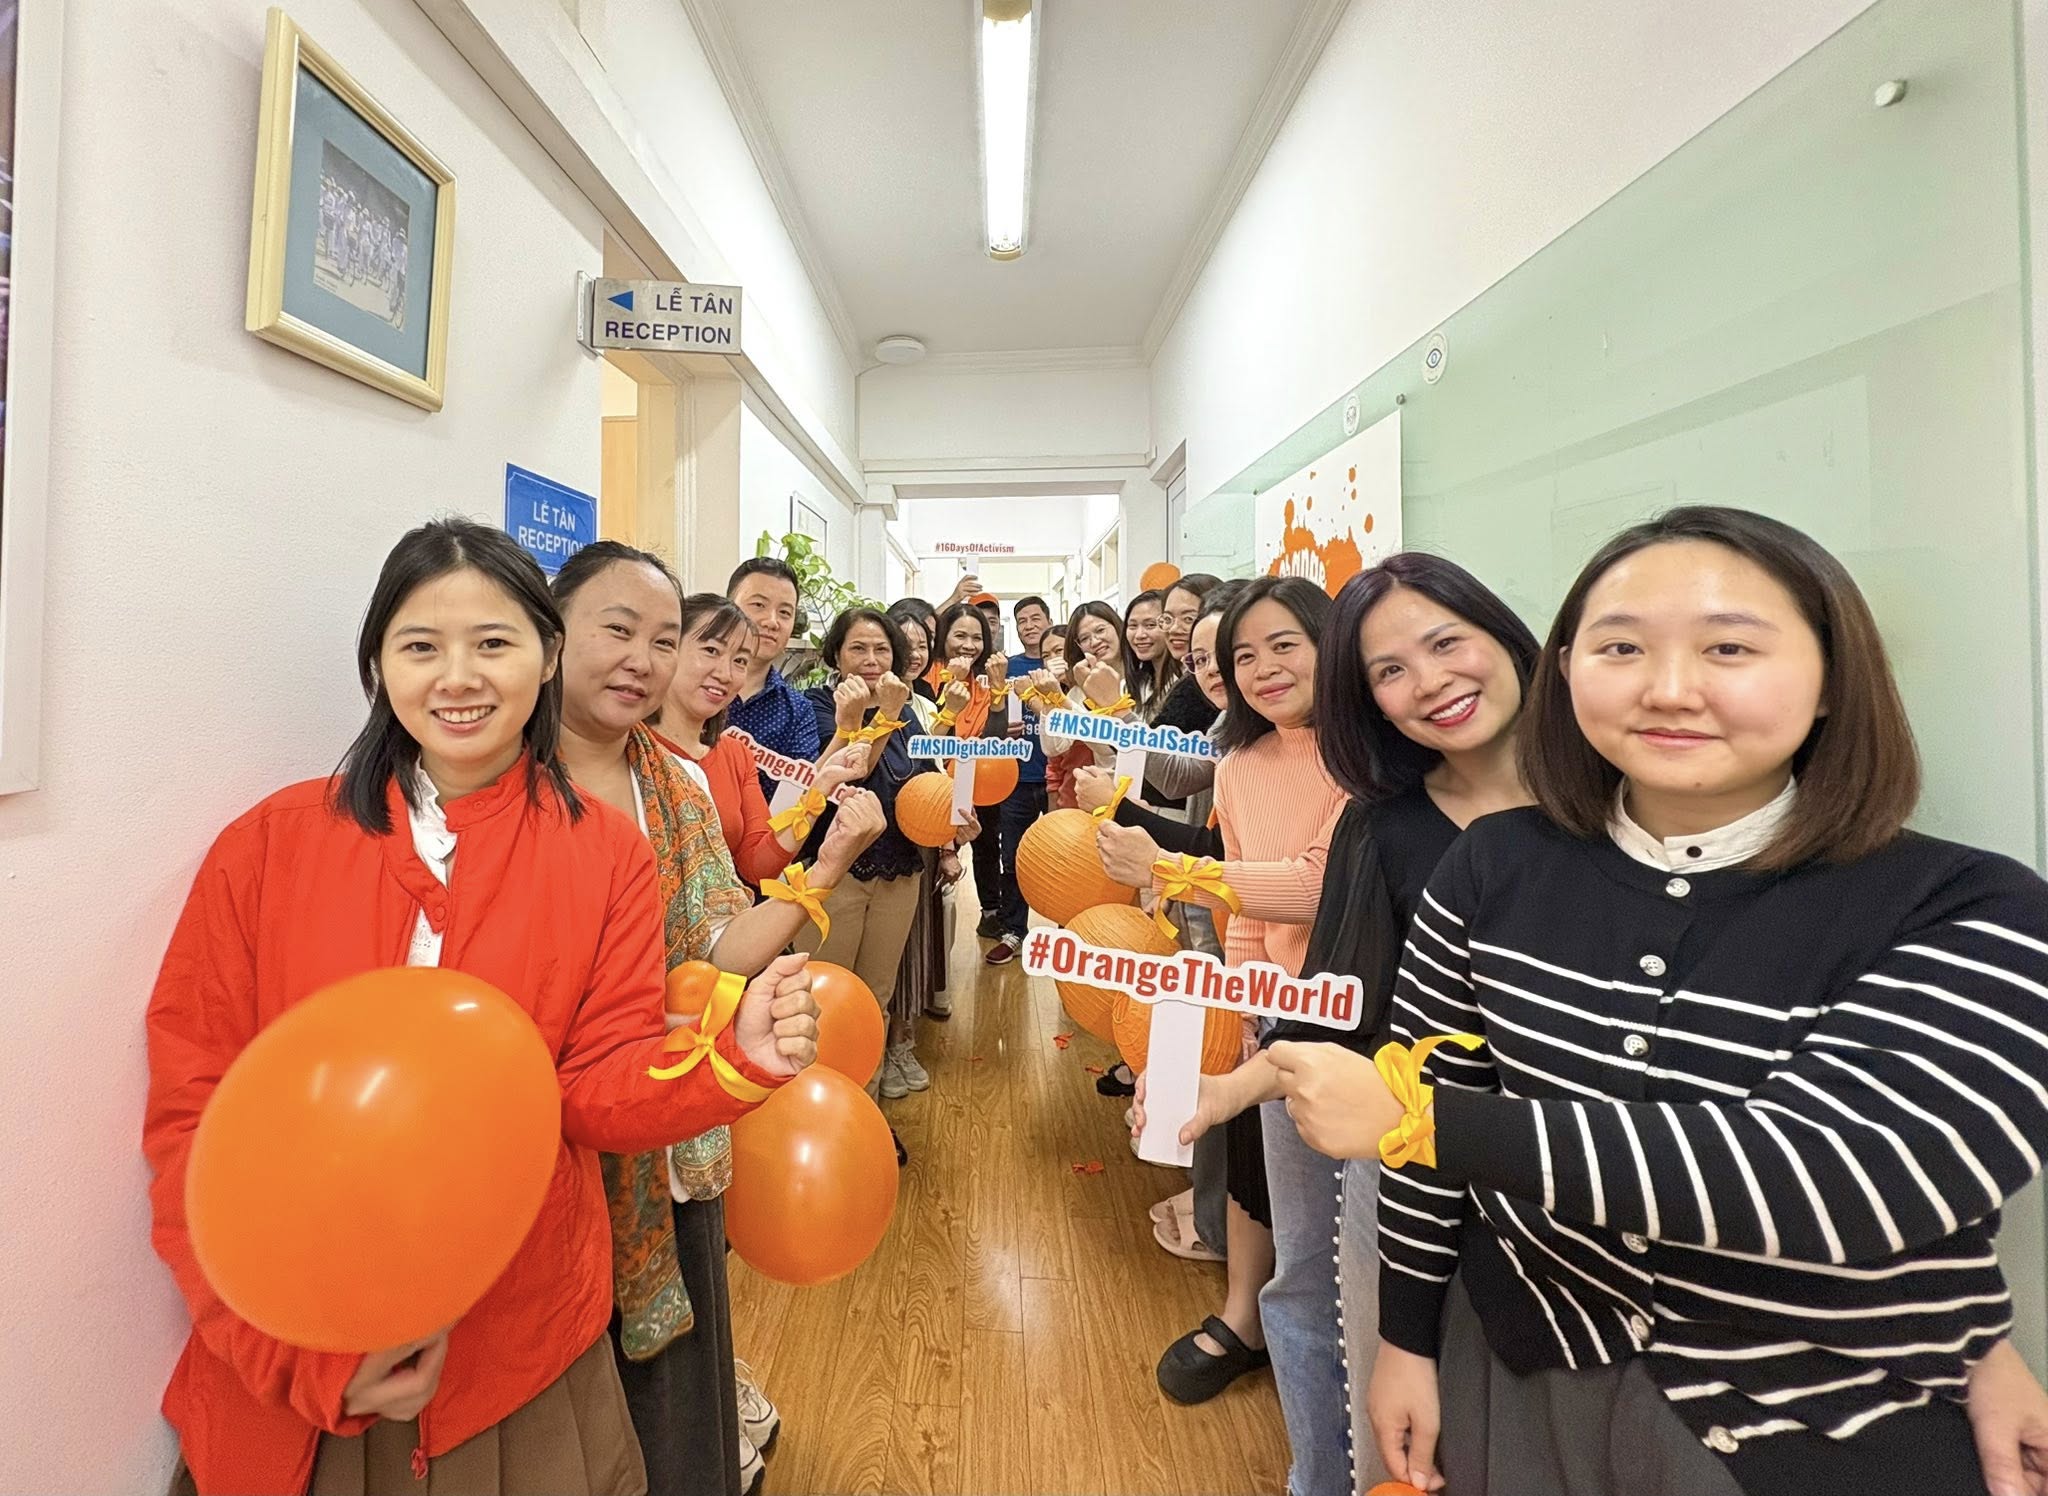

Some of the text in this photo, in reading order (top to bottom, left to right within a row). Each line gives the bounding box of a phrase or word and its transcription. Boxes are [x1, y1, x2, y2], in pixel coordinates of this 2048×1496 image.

[656, 287, 733, 315] LỄ TÂN
[605, 321, 732, 344] RECEPTION
[552, 506, 576, 532] TÂN
[518, 525, 587, 556] RECEPTIO
[935, 542, 1015, 553] #16DaysOfActivism
[911, 738, 1031, 759] #MSIDigitalSafety
[1049, 712, 1219, 758] #MSIDigitalSafet
[1029, 933, 1355, 1021] #OrangeTheWorld
